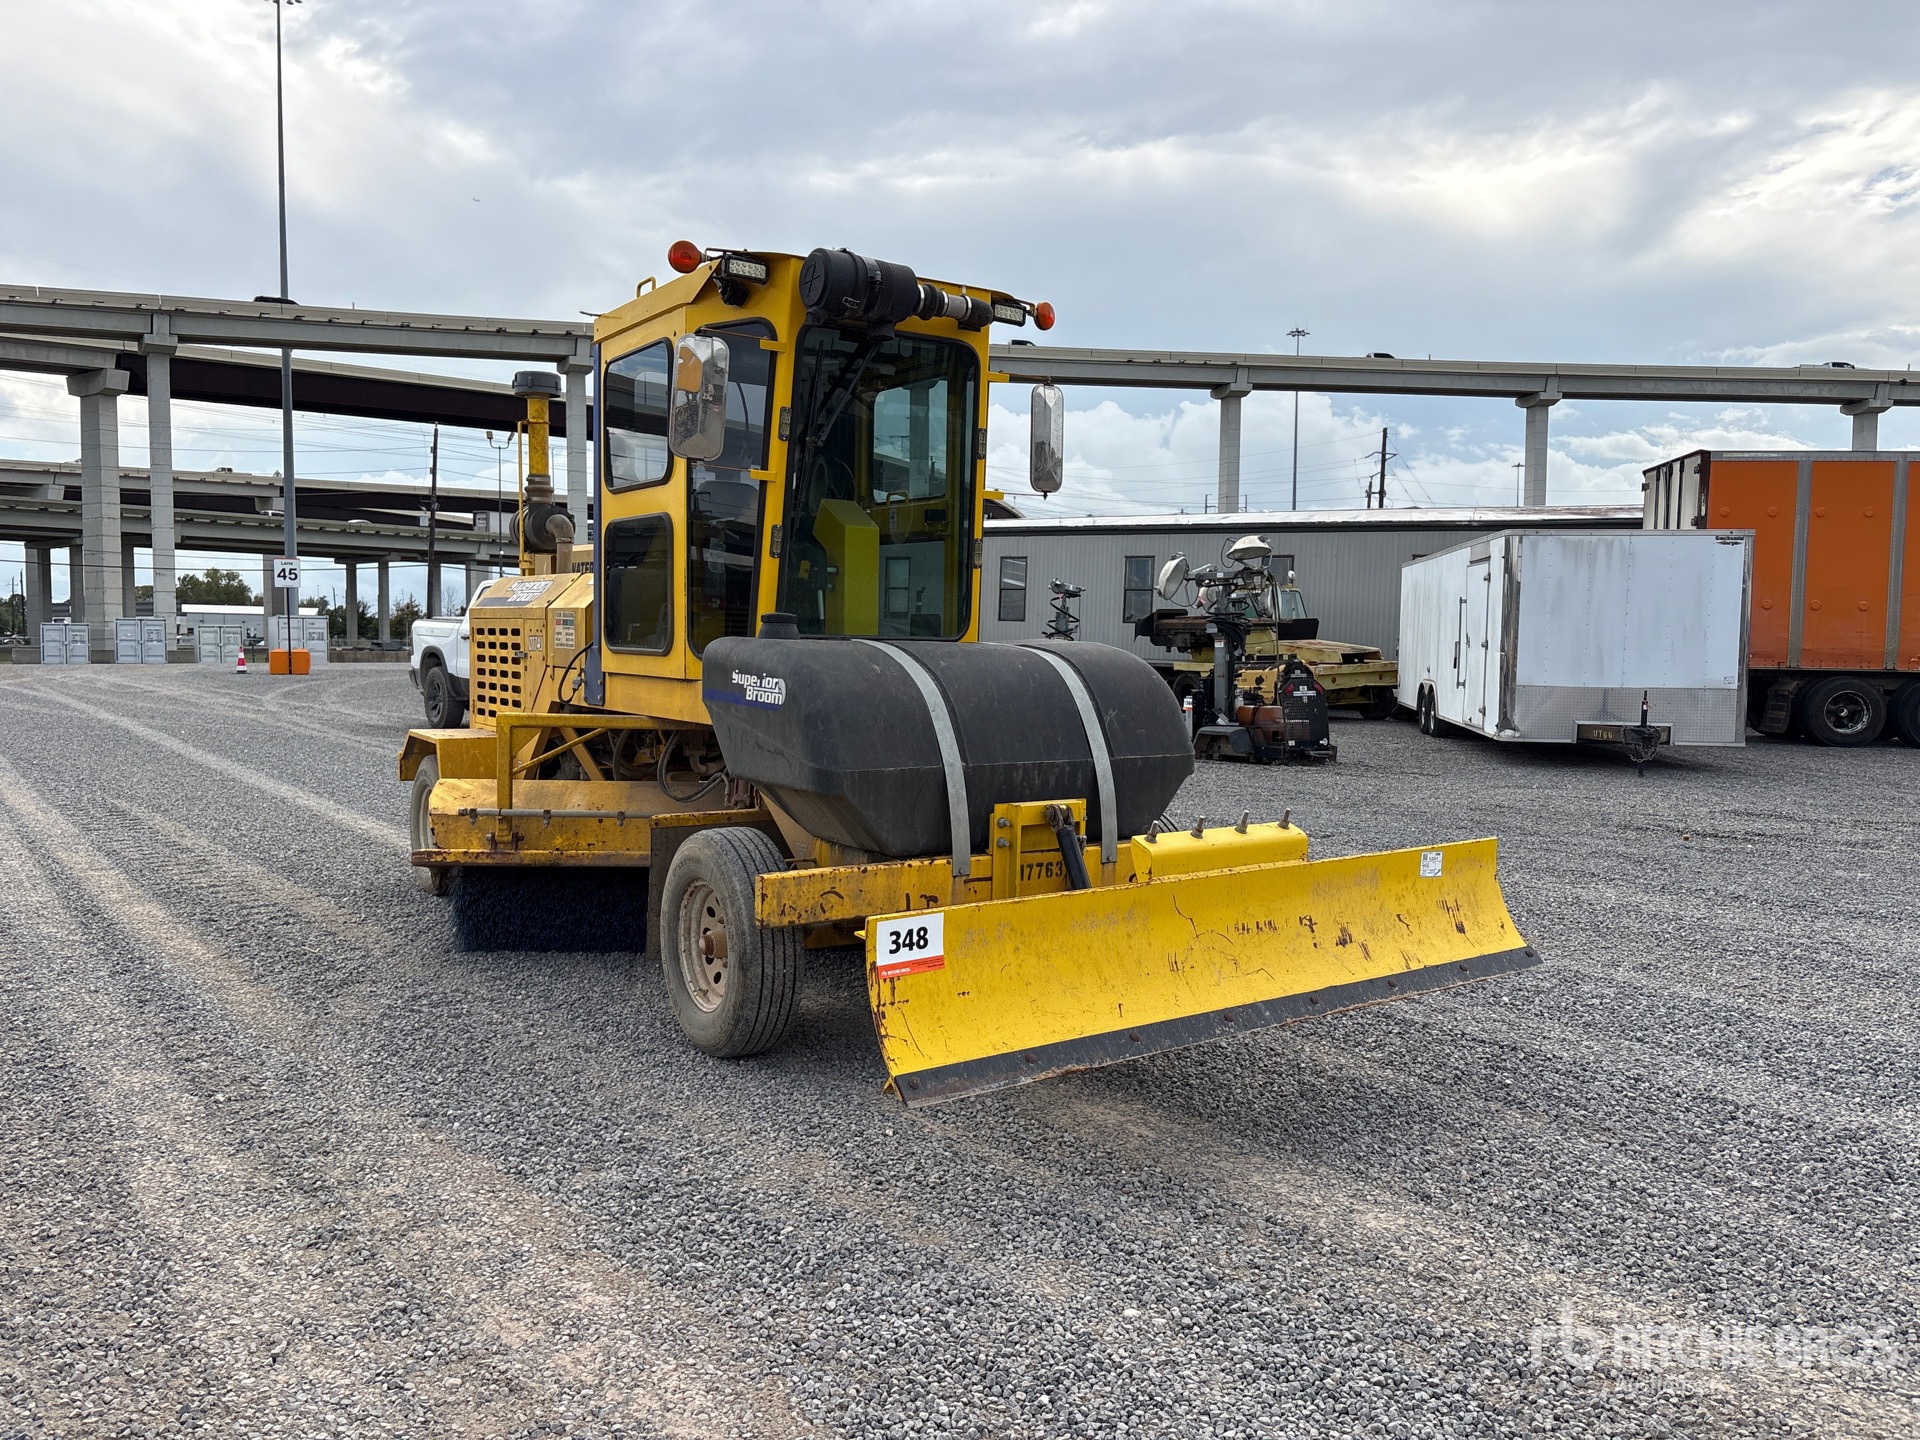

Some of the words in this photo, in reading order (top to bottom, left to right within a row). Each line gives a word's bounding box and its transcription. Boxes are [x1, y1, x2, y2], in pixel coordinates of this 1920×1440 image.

[277, 567, 298, 581] 45
[731, 669, 779, 689] Superior
[745, 686, 783, 706] Broom
[1020, 860, 1063, 881] 17763
[889, 926, 929, 955] 348
